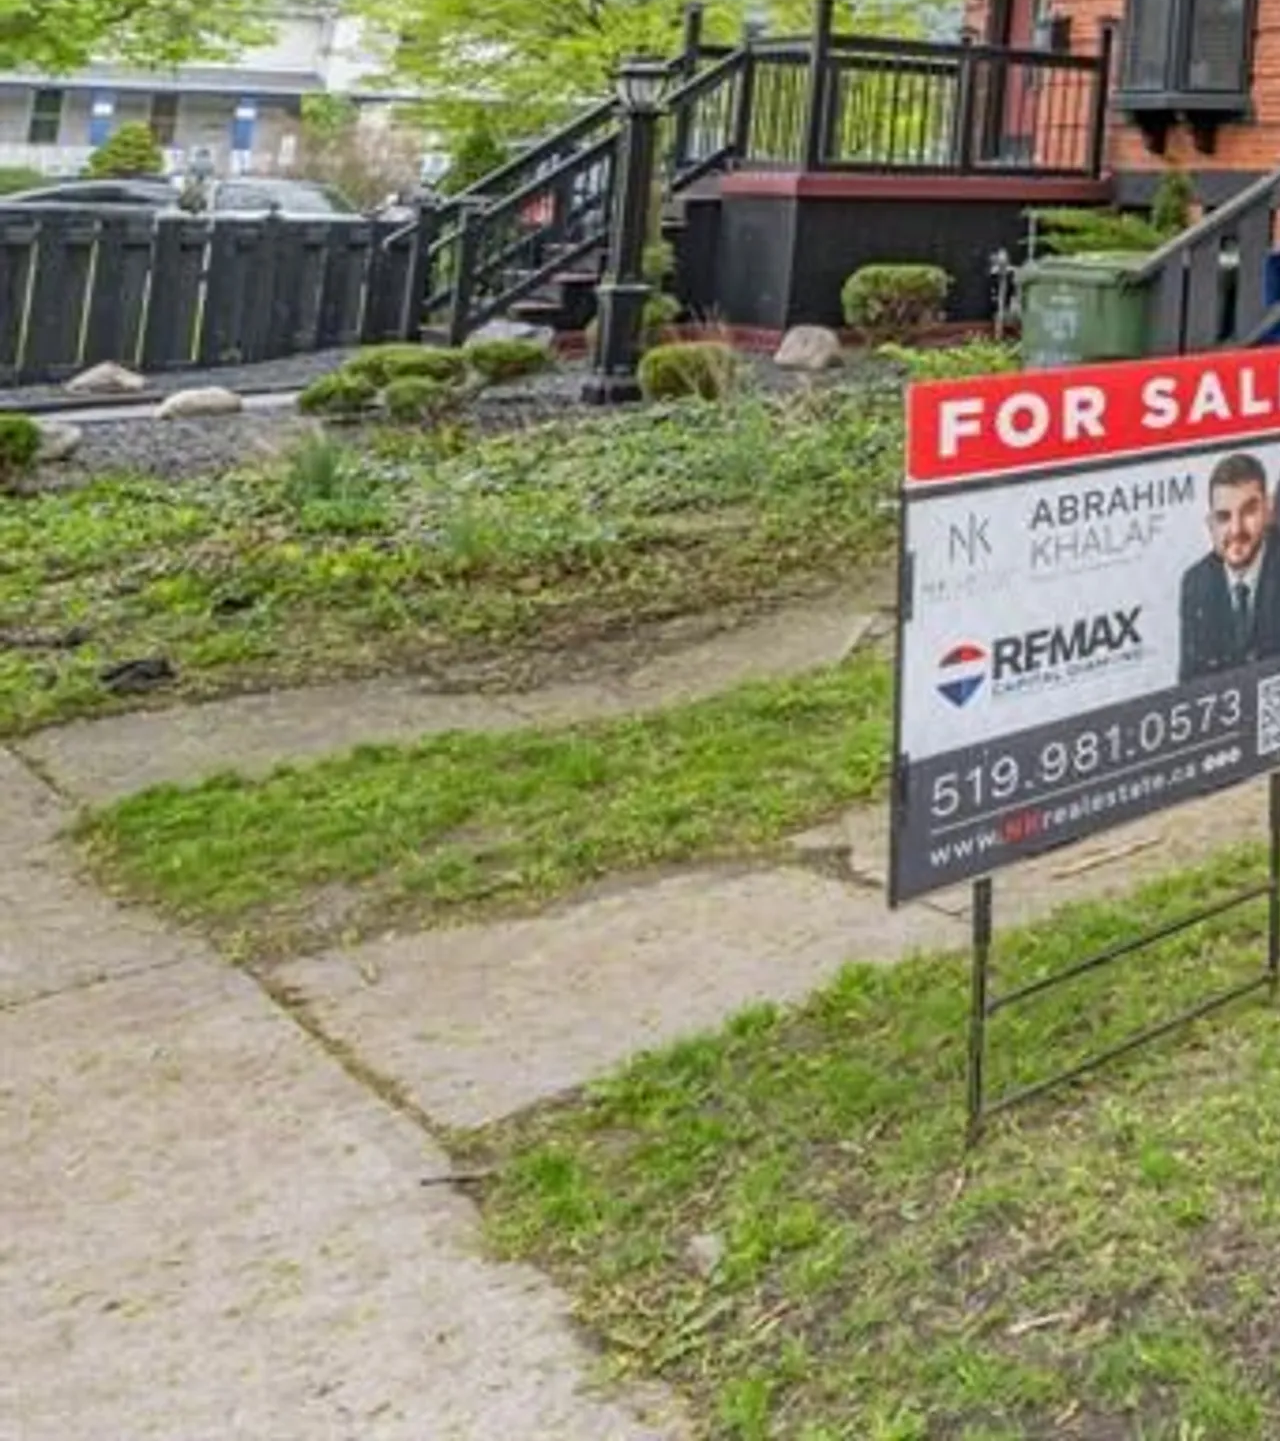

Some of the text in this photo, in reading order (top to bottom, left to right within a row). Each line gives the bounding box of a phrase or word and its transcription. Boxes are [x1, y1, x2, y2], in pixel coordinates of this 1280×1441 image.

[937, 385, 1106, 457] FOR
[1029, 474, 1196, 531] ABRAHIM
[1030, 513, 1165, 569] KHALAF
[930, 688, 1242, 818] 519.981.0573
